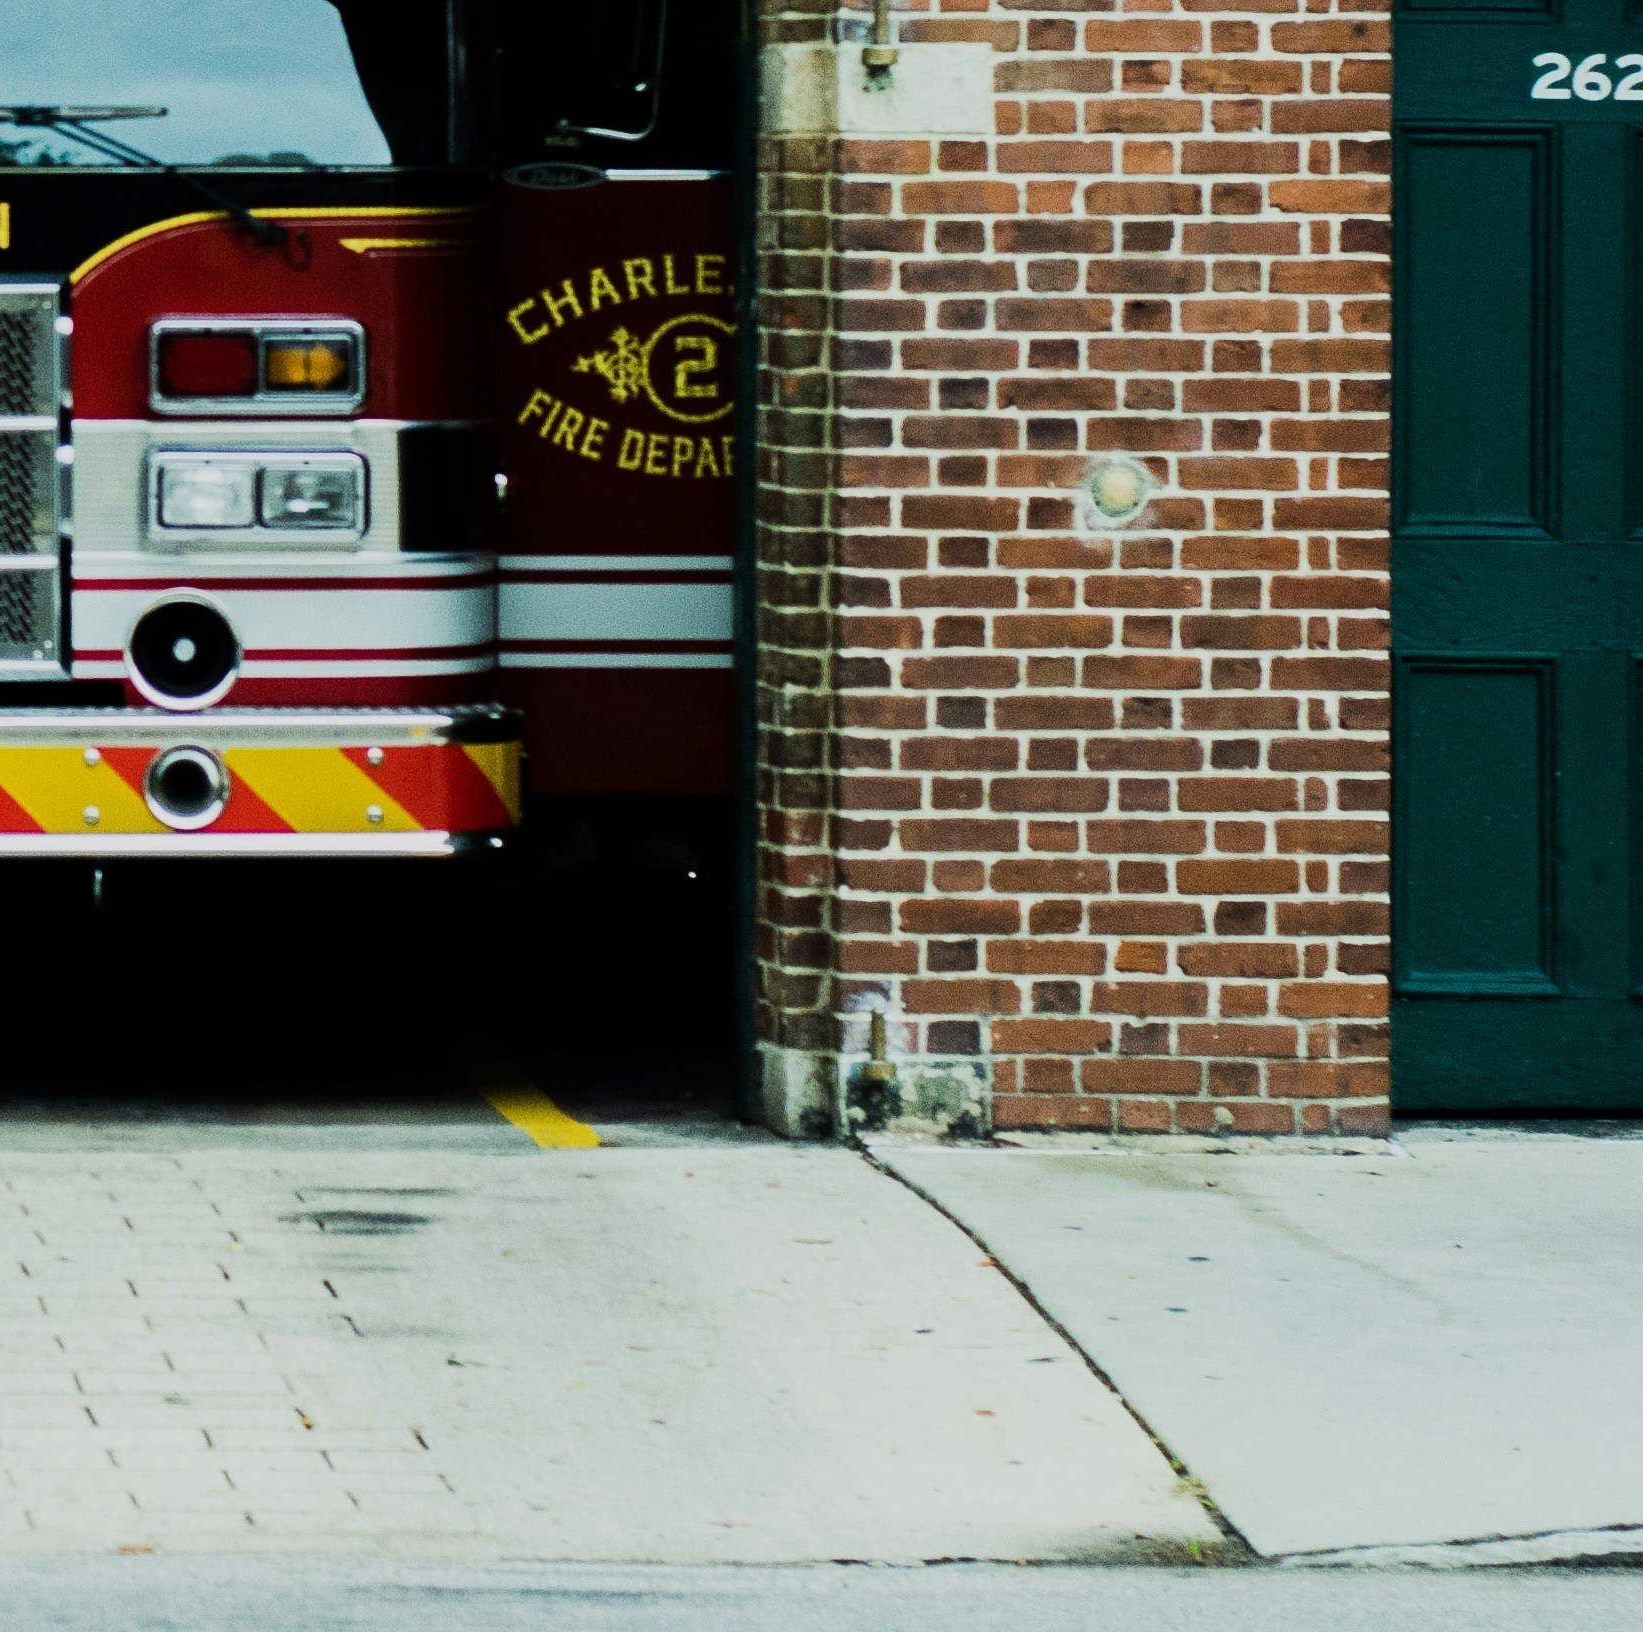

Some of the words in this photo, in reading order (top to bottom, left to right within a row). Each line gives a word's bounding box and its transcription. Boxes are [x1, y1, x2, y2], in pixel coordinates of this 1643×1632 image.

[1531, 52, 1643, 101] 262
[506, 253, 734, 345] CHARLE
[673, 334, 720, 399] 2
[516, 387, 612, 461] FIRE
